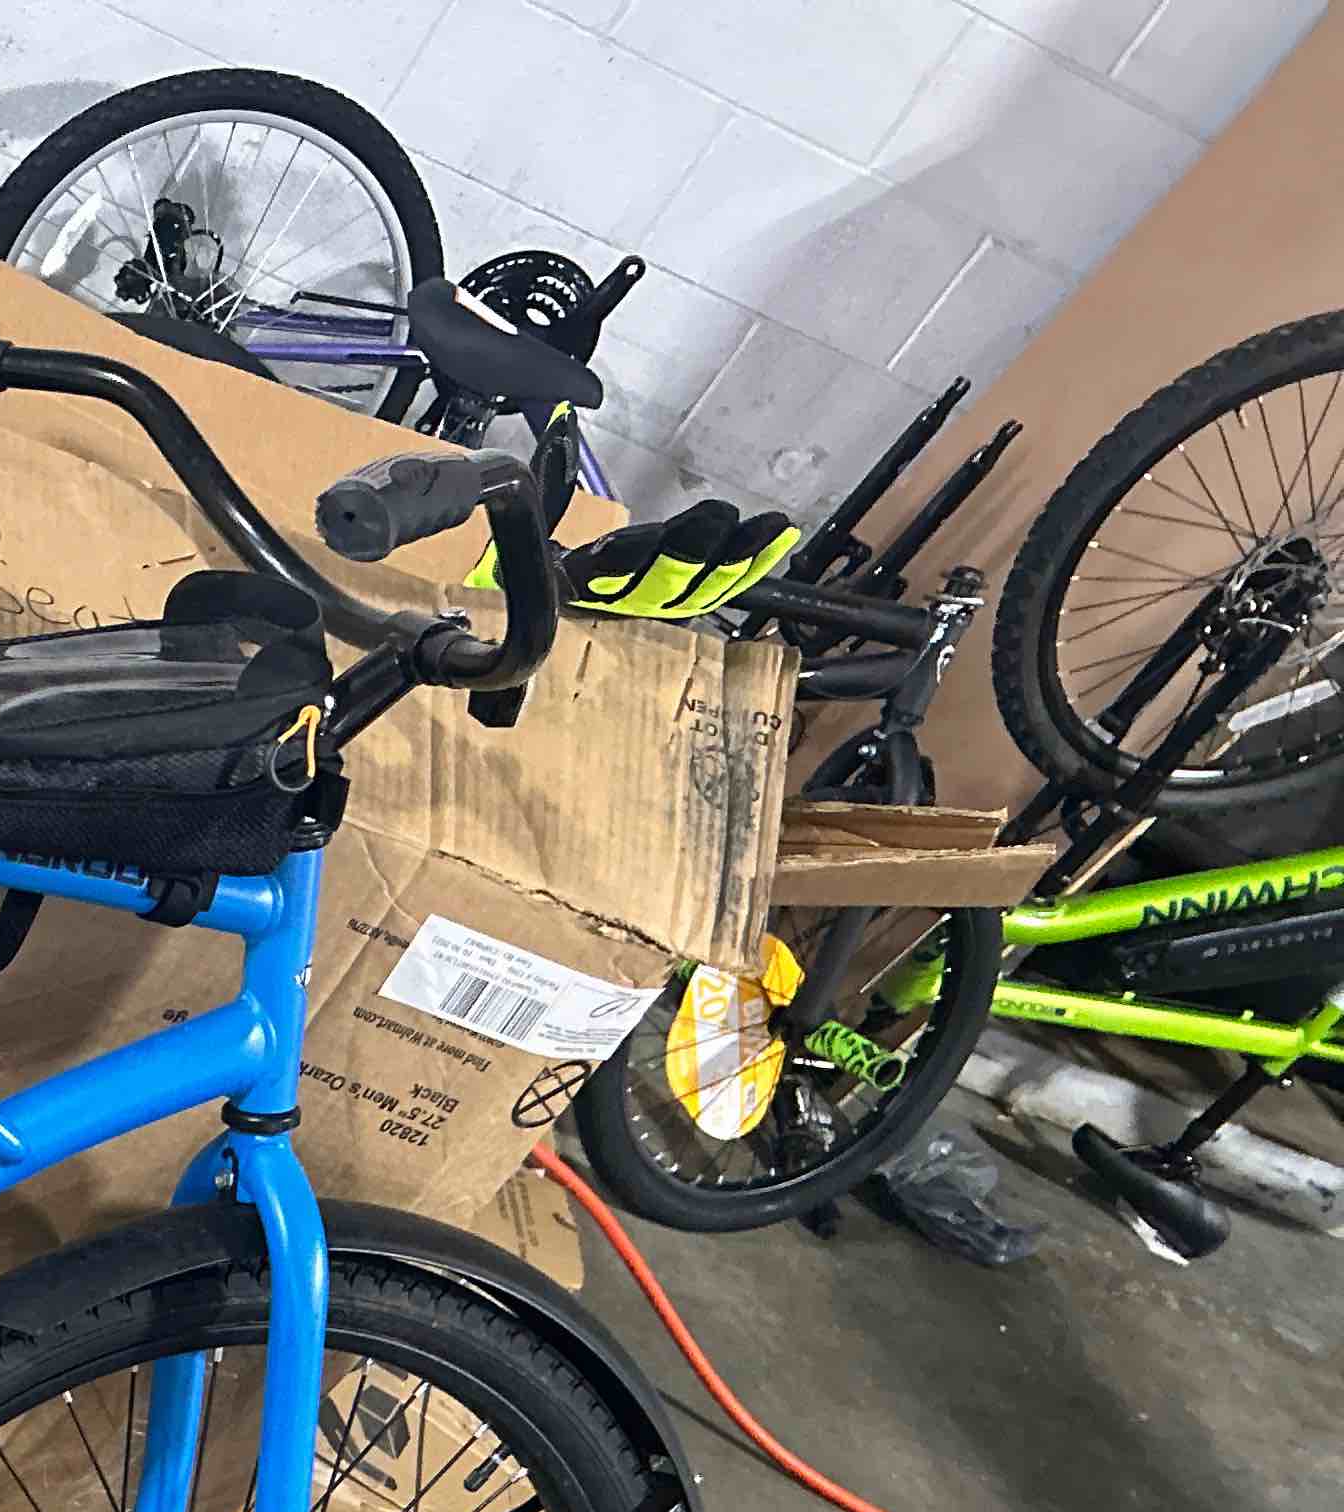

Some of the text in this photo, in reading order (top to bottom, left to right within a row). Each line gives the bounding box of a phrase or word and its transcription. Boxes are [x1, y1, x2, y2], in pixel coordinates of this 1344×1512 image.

[353, 1006, 424, 1044] Walmart.com
[421, 1037, 437, 1050] at
[436, 1042, 466, 1060] more
[462, 1054, 492, 1073] Find
[348, 1082, 400, 1112] Men's
[409, 1083, 461, 1113] Black
